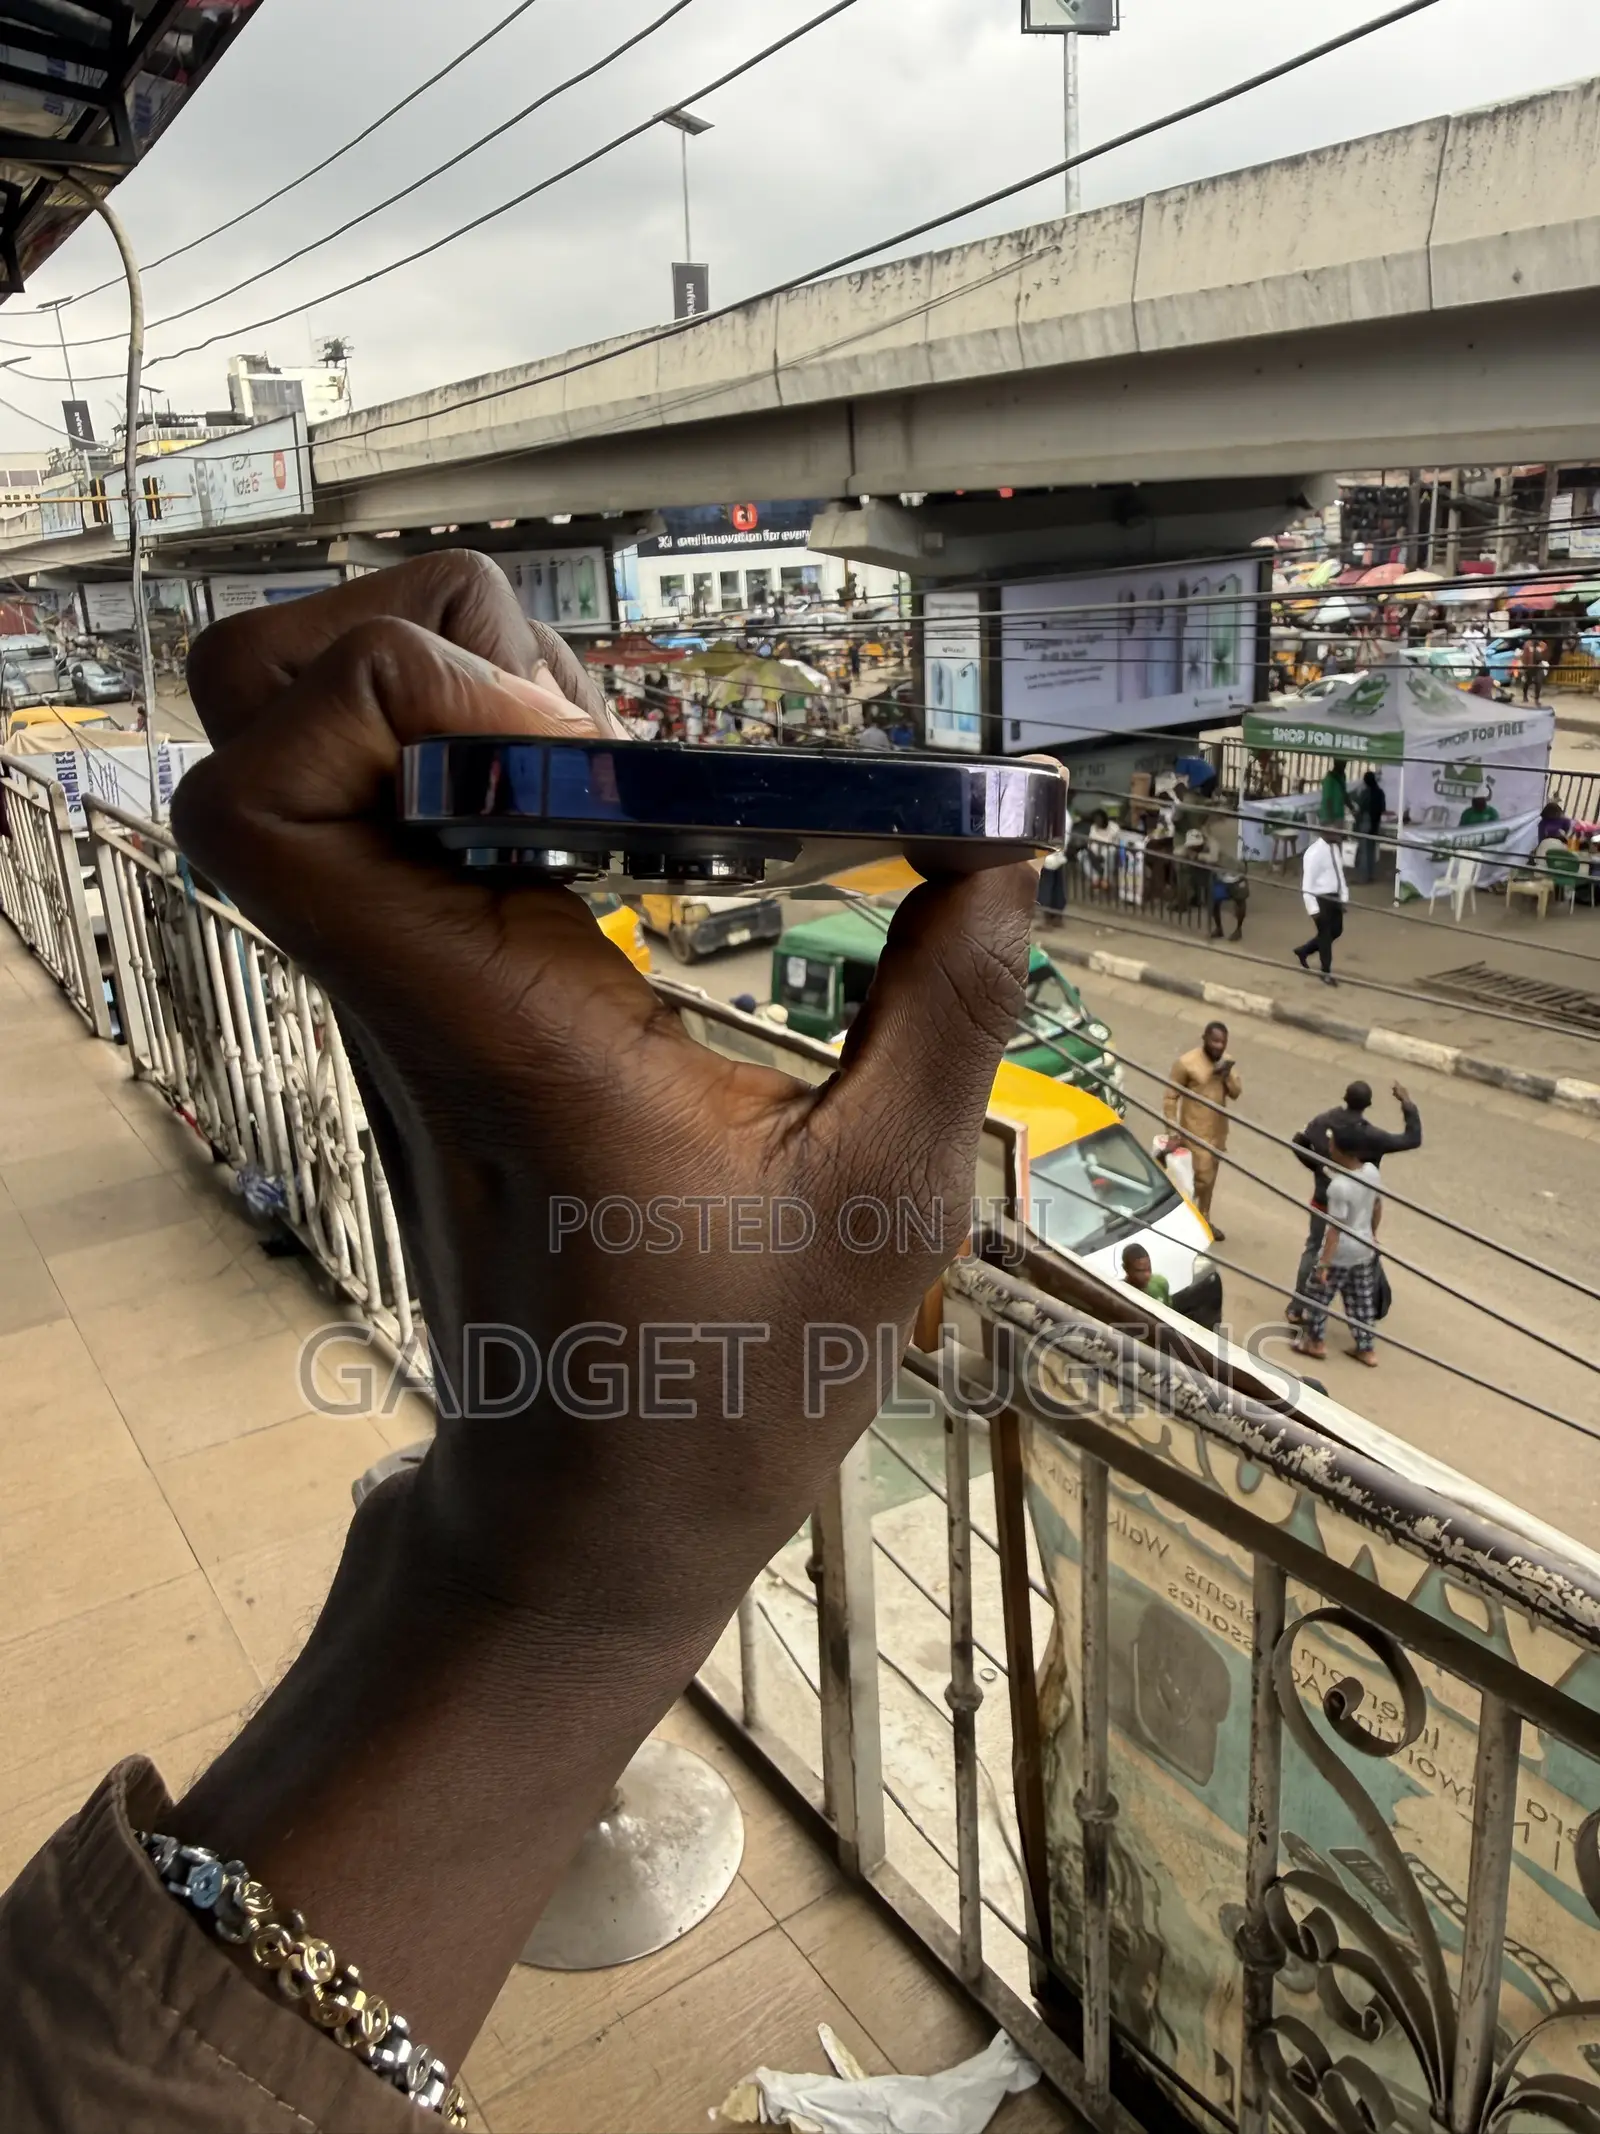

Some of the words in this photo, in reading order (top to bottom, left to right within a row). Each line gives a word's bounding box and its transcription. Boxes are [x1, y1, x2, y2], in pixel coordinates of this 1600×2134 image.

[1273, 727, 1306, 743] SHOP
[1307, 730, 1333, 748] FOR
[1335, 733, 1369, 751] FREE
[1437, 731, 1469, 750] SHOP
[1470, 722, 1496, 743] FOR
[1498, 720, 1526, 739] FREE
